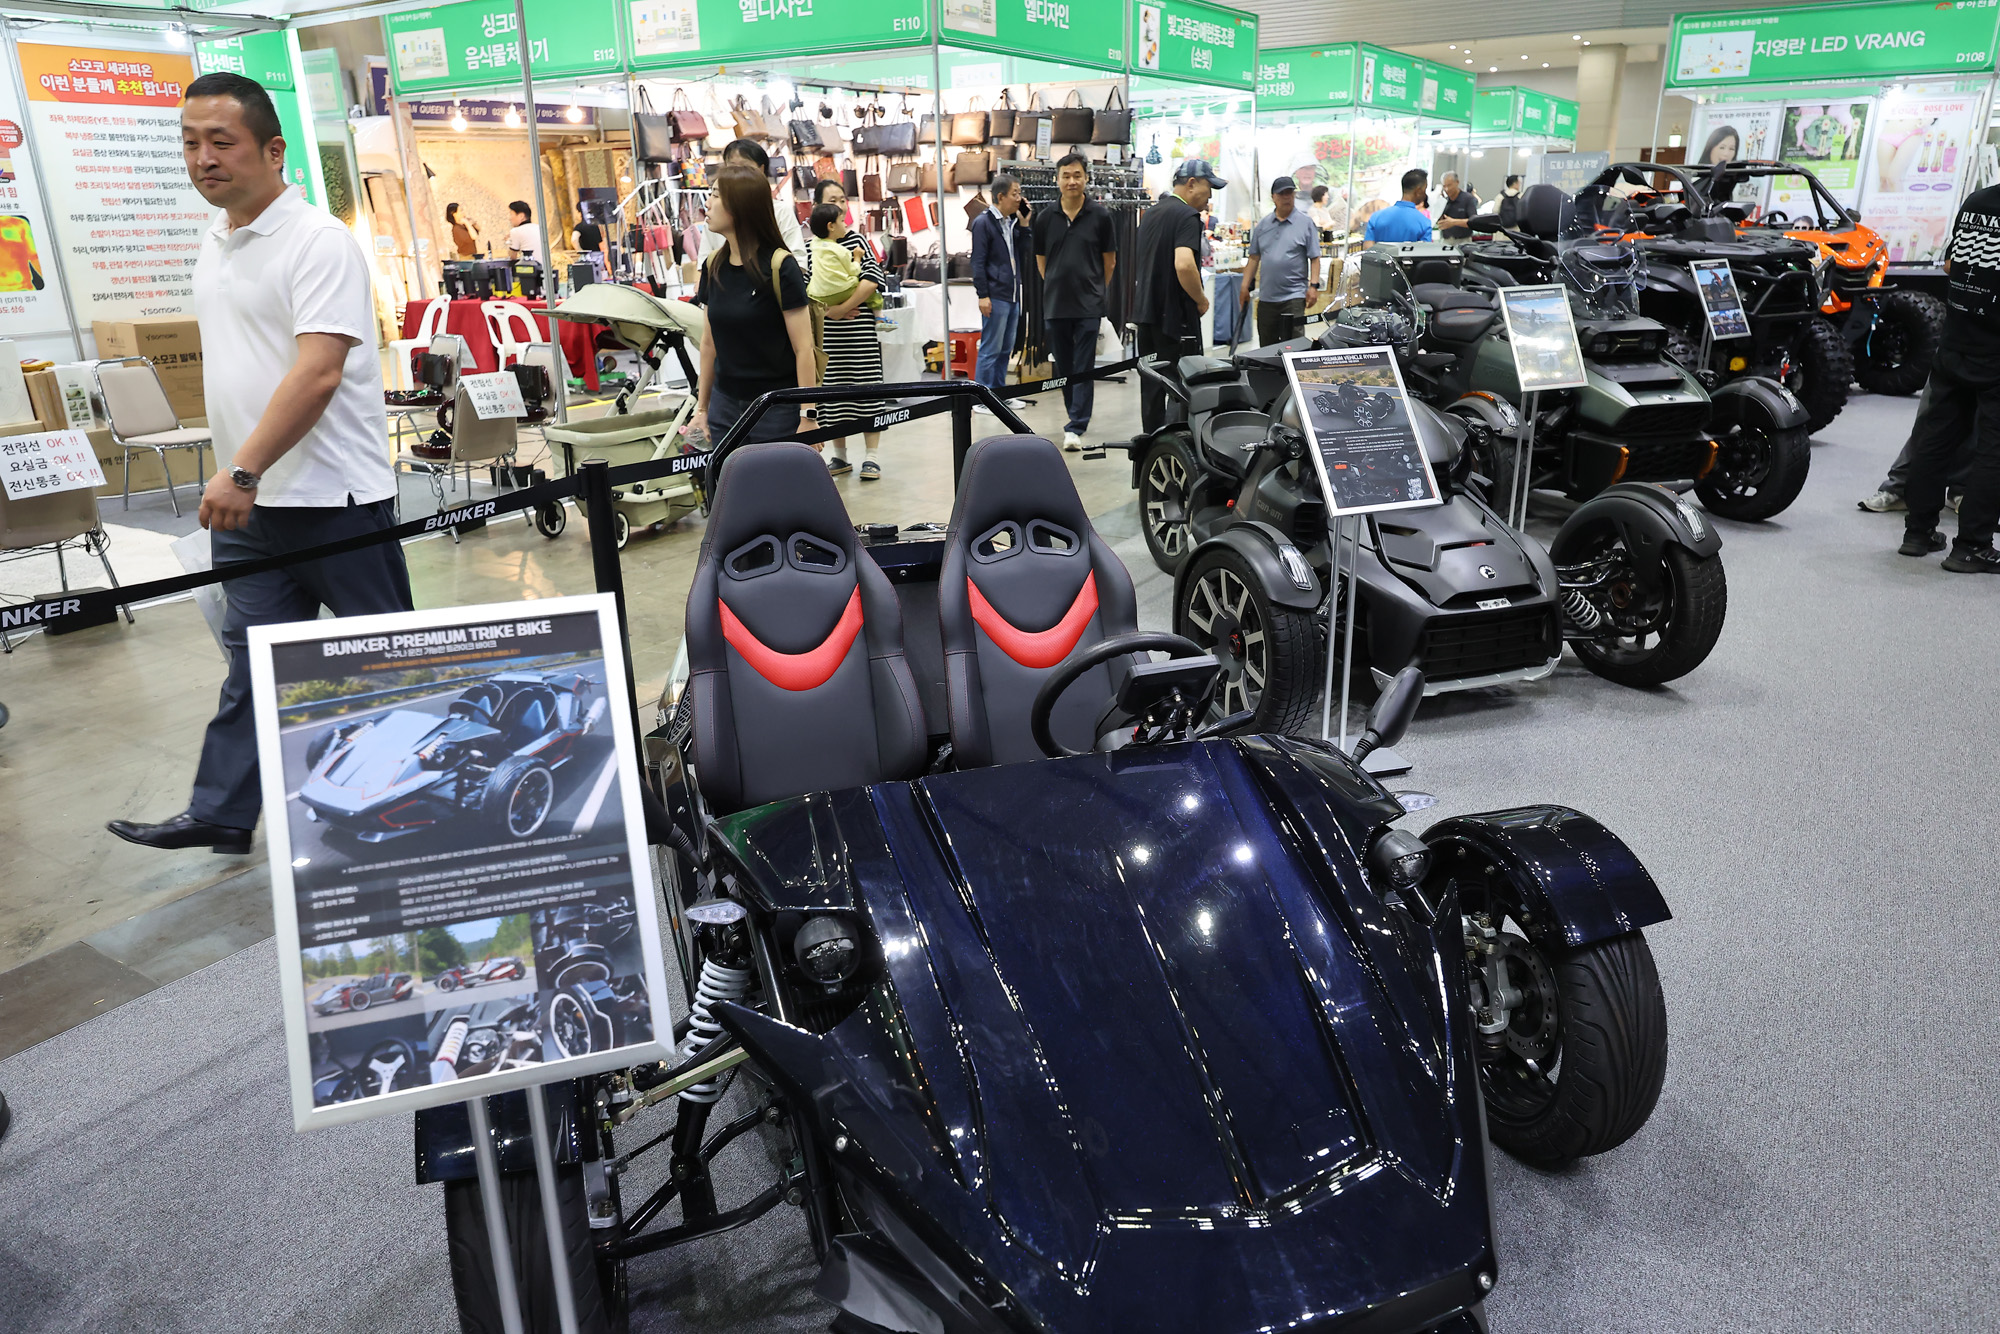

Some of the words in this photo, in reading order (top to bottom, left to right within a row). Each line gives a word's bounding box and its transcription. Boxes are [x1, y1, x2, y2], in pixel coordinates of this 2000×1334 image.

[893, 16, 921, 31] E110
[1754, 38, 1807, 57] 지영란
[1811, 36, 1848, 53] LED
[1854, 30, 1926, 50] VRANG
[593, 49, 615, 61] E112
[1956, 52, 1986, 63] D108
[68, 58, 106, 74] 소모코
[107, 63, 154, 78] 세라피온
[266, 72, 287, 82] F111
[40, 74, 70, 91] 이런
[72, 77, 115, 94] 분들께
[117, 80, 182, 98] 추천합니다
[420, 105, 446, 115] QUEEN
[471, 107, 488, 116] 1979
[1923, 104, 1942, 112] ROSE
[153, 353, 178, 364] 소모코
[1041, 377, 1068, 391] BUNKER
[874, 409, 911, 428] BUNKER
[1, 440, 41, 456] 전립선
[46, 437, 65, 448] OK
[10, 457, 48, 472] 요실금
[9, 474, 61, 493] 전신통증
[424, 501, 496, 531] BUNKER
[1, 598, 81, 628] NKER
[323, 637, 390, 657] BUNKER
[392, 629, 467, 650] PREMIUM
[468, 624, 515, 642] TRIKE
[516, 620, 553, 637] BIKE
[475, 640, 497, 651] 바이크
